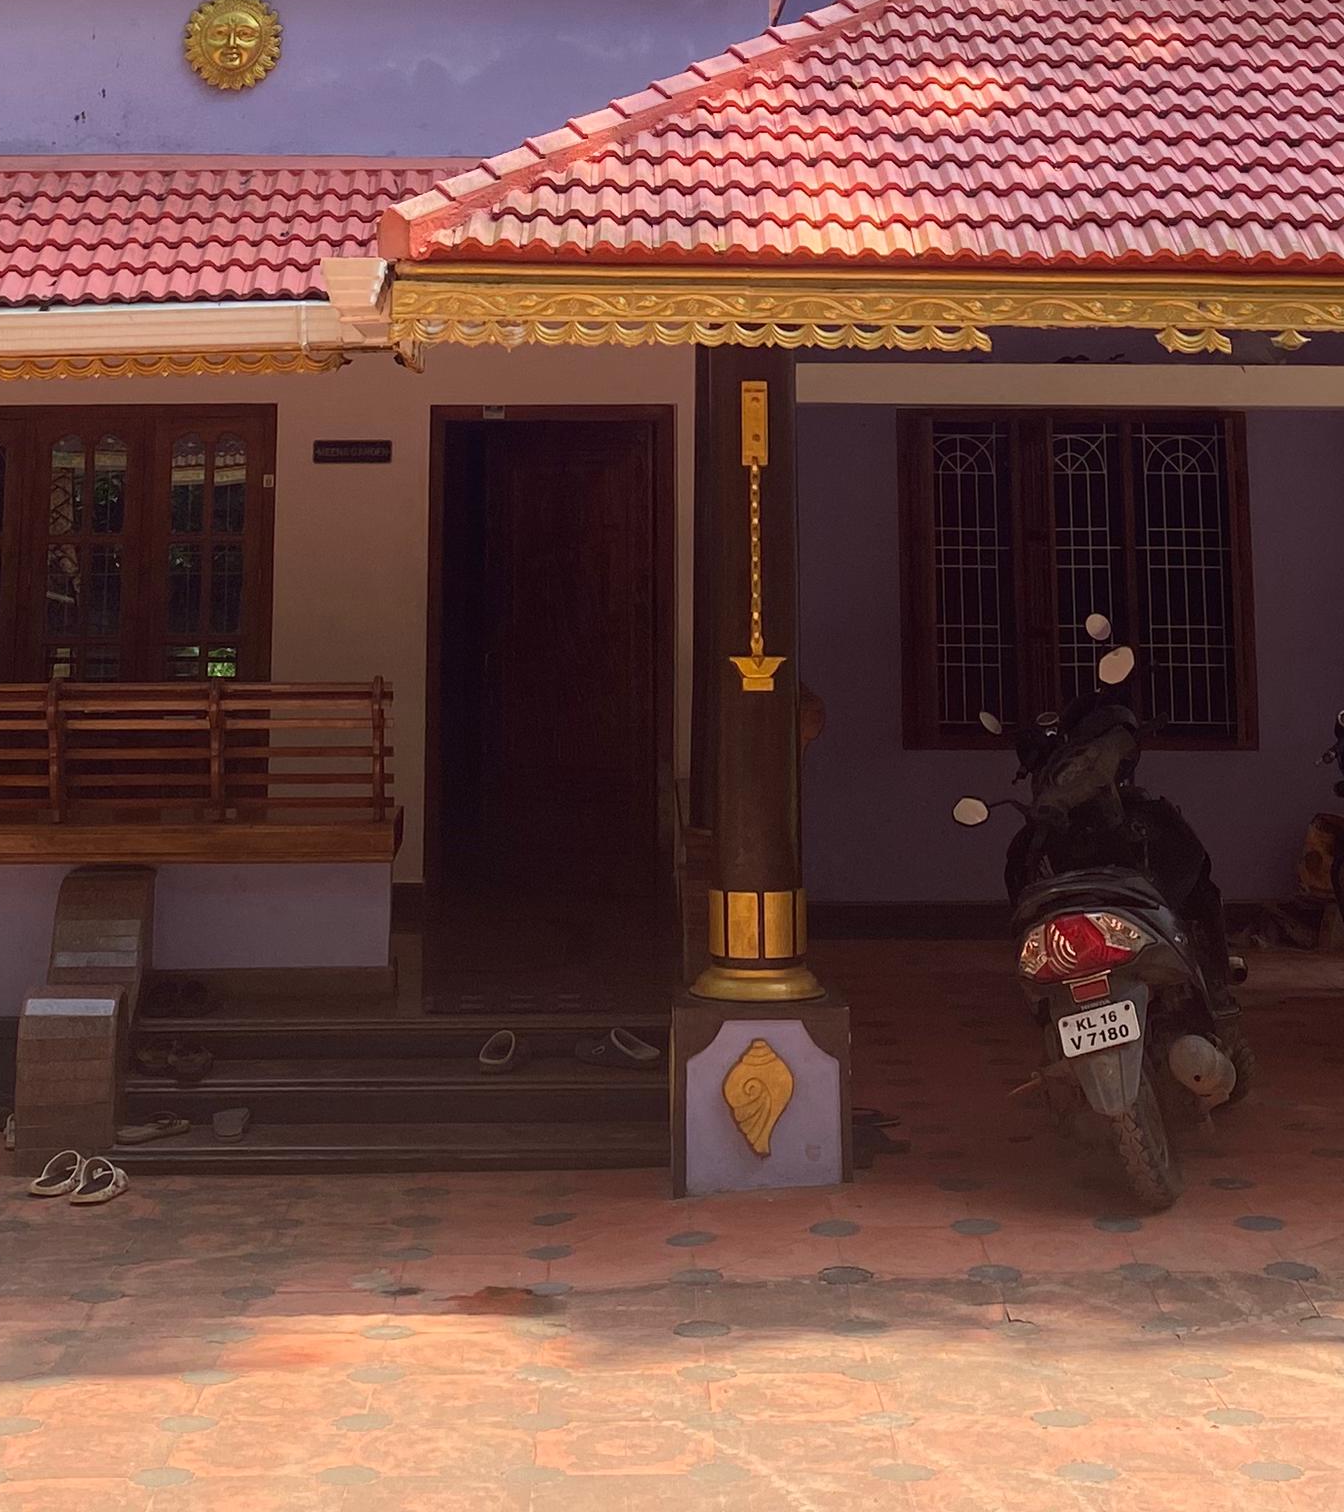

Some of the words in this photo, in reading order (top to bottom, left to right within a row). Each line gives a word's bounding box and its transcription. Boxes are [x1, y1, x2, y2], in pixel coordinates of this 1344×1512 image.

[1076, 1017, 1097, 1032] KL
[1100, 1010, 1117, 1024] 16
[1070, 1036, 1082, 1050] V
[1086, 1024, 1129, 1046] 7180
